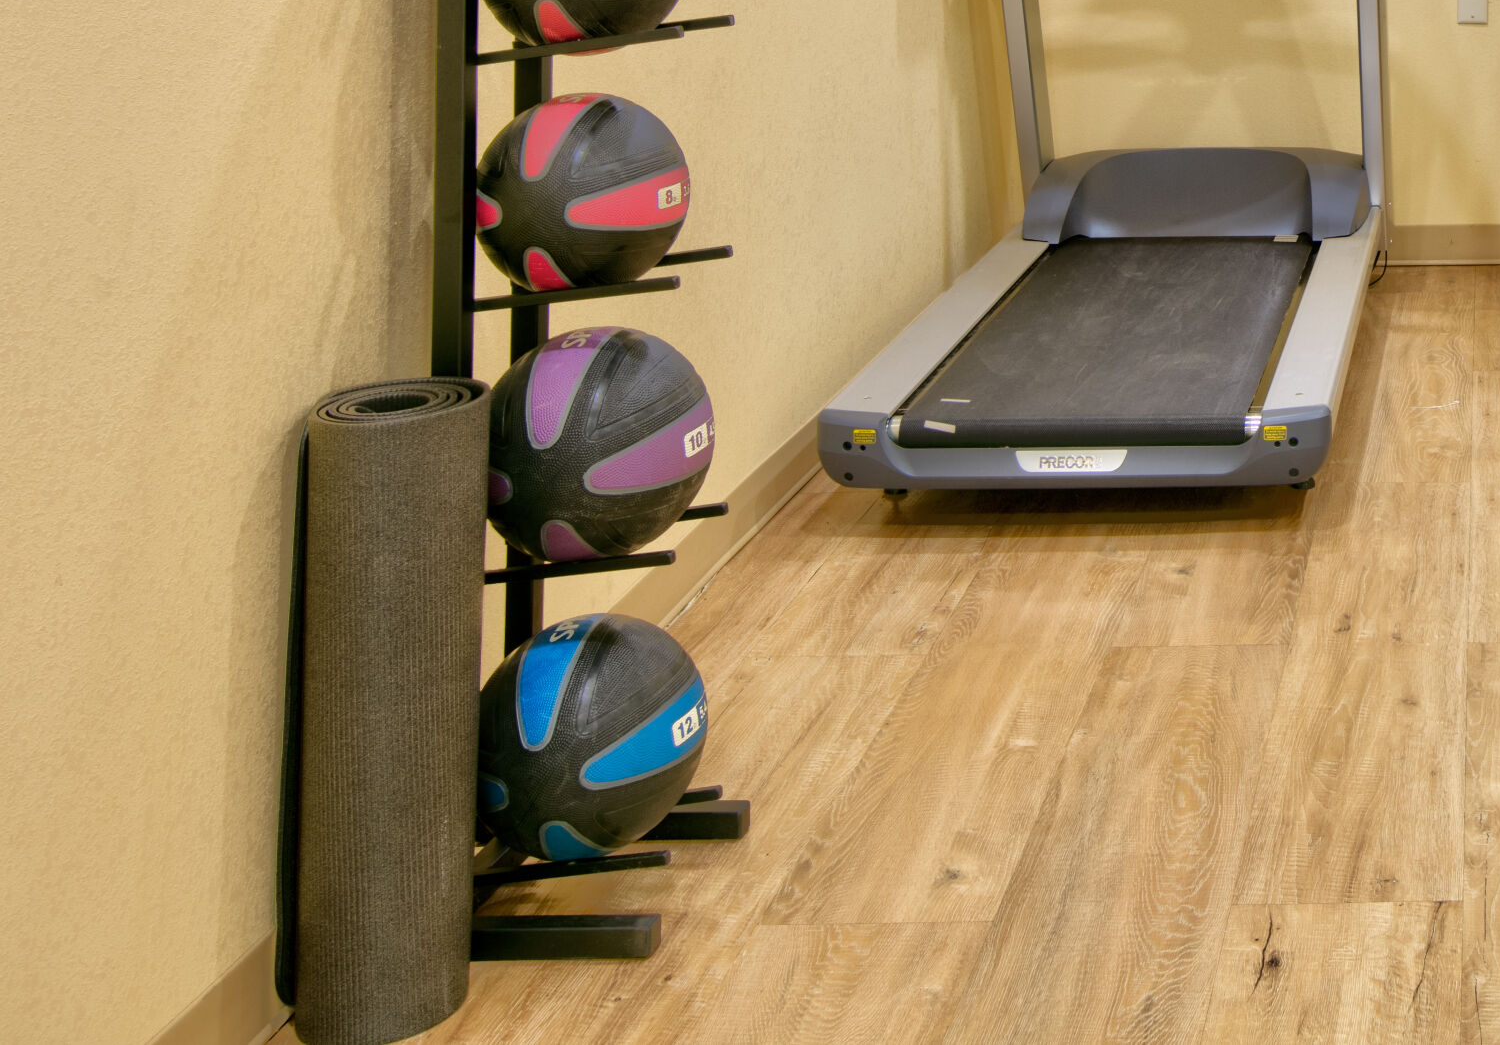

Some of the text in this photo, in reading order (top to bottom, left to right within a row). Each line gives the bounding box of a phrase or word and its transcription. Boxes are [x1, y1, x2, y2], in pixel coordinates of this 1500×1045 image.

[665, 189, 673, 205] 8
[689, 430, 703, 451] 10
[677, 716, 694, 739] 12
